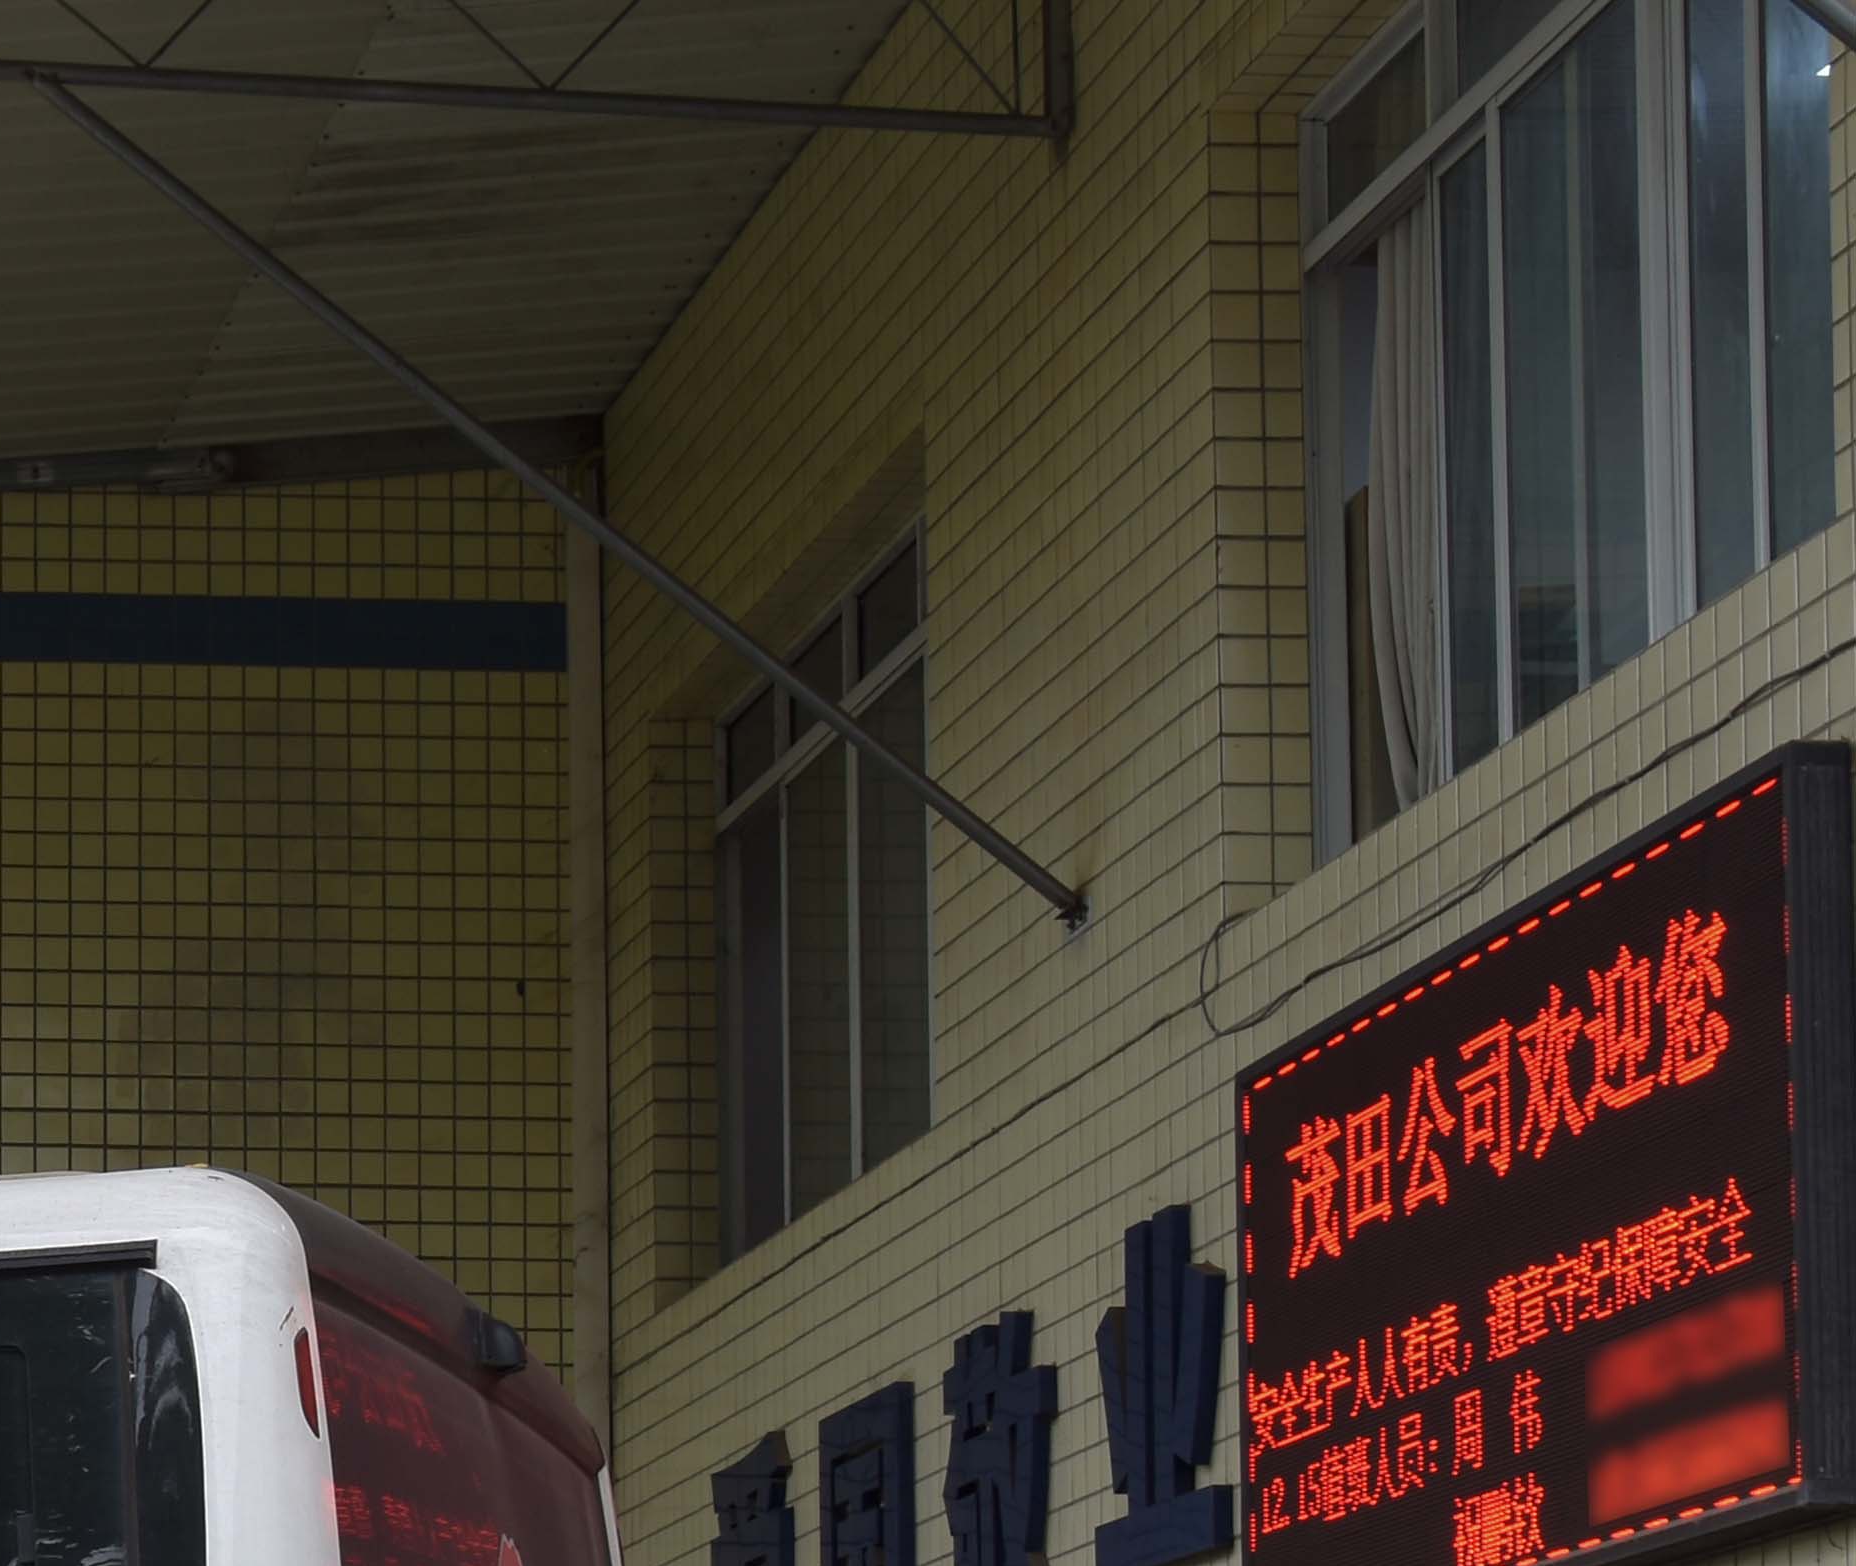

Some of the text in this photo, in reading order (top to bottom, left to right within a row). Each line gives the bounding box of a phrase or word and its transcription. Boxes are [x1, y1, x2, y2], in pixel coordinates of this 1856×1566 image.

[1285, 908, 1729, 1278] 茂田公司欢迎您
